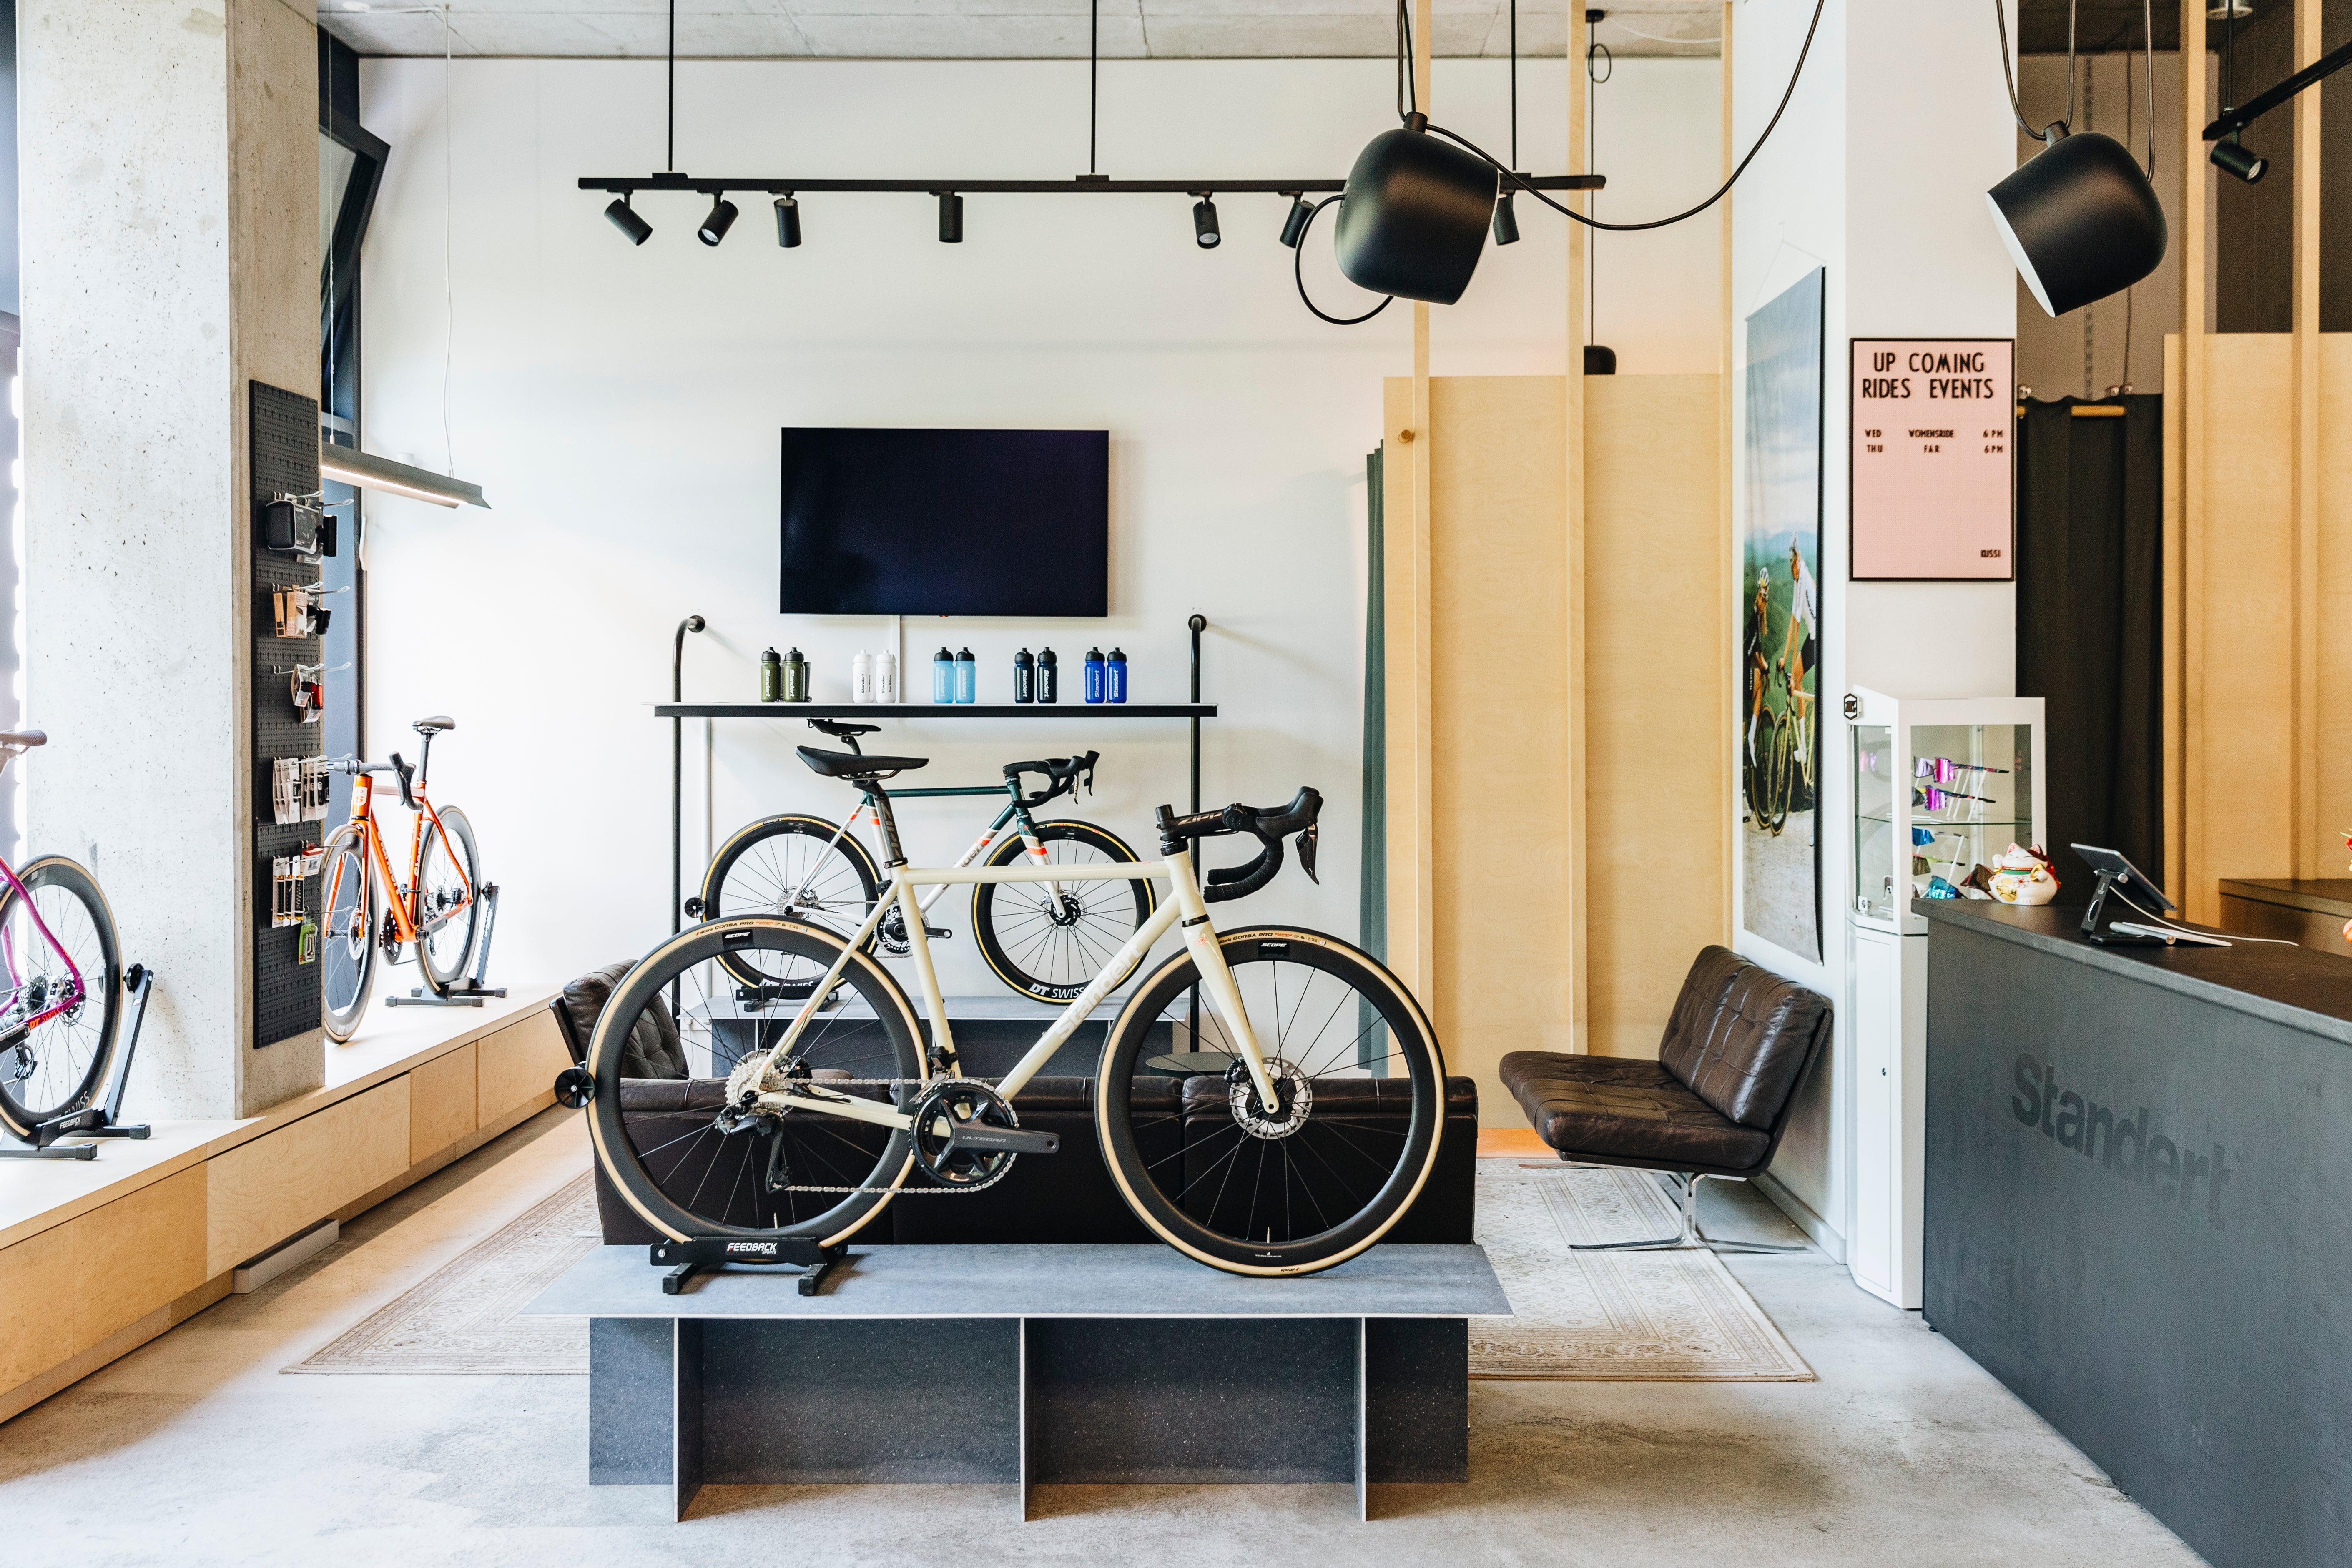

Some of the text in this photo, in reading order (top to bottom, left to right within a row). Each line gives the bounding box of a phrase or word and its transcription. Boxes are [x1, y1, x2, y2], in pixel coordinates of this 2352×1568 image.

[1874, 352, 1984, 373] UP COMING
[1863, 378, 1993, 399] RIDES EVENTS
[1908, 429, 1954, 438] WOMENSRIDE
[1983, 429, 1988, 438] 6
[1991, 429, 2003, 438] PM
[1984, 445, 1989, 454] 6
[1991, 445, 2003, 453] PM
[1178, 811, 1222, 825] ZIPP
[1029, 983, 1050, 996] DT
[1055, 938, 1143, 1041] Standert
[30, 1008, 60, 1029] DT SWISS
[2012, 1053, 2232, 1232] Standert
[727, 1242, 778, 1252] FEEDBACK
